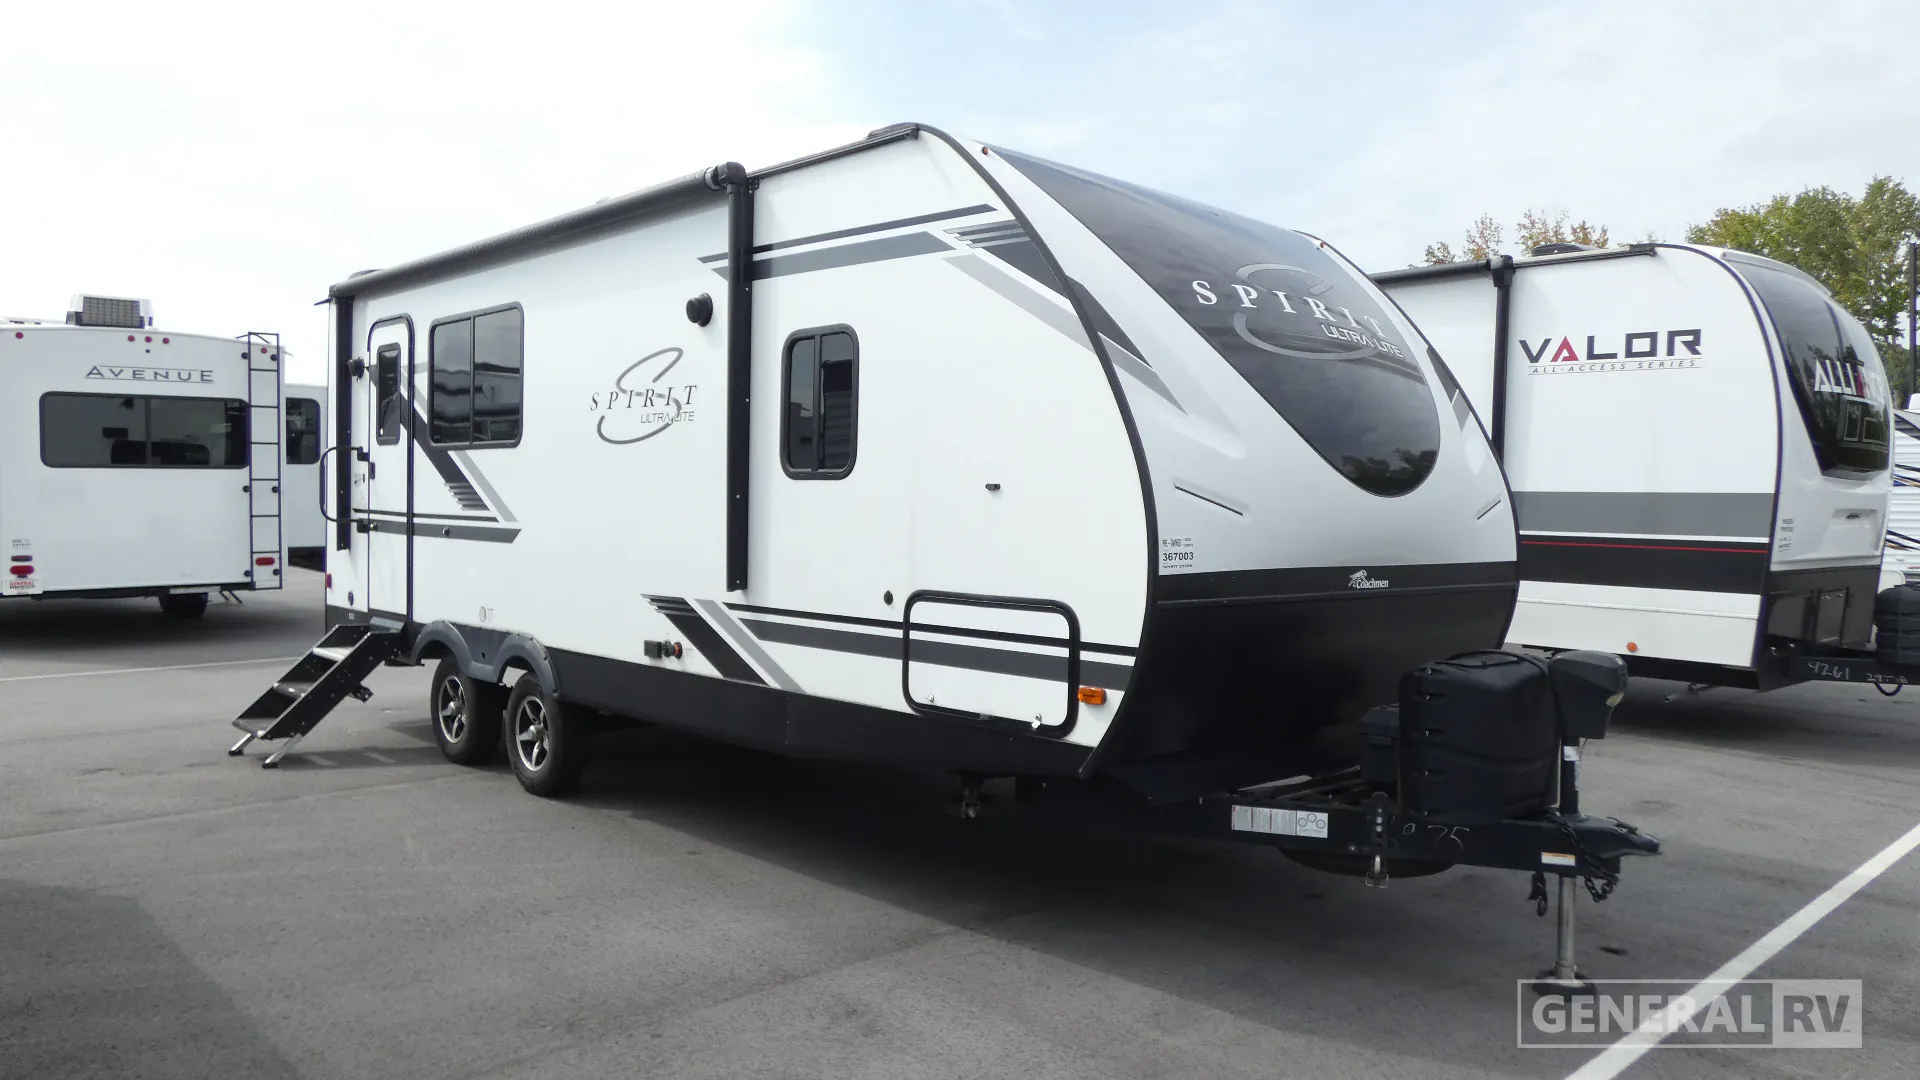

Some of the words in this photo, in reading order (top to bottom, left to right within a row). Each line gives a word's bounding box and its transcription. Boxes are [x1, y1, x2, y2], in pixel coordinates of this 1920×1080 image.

[1192, 280, 1387, 338] SPIRIT
[1321, 324, 1374, 348] ULTRA
[1373, 338, 1404, 358] LITE
[1518, 329, 1702, 363] VALOR
[86, 365, 213, 382] AVENUE
[1532, 363, 1626, 374] ALL-ACCESS
[1638, 360, 1696, 369] SERIES
[590, 385, 697, 411] SPIRIT
[640, 412, 672, 424] ULTRA
[674, 411, 695, 422] LITE
[1162, 551, 1194, 562] 367003
[1356, 578, 1389, 589] Coachmen
